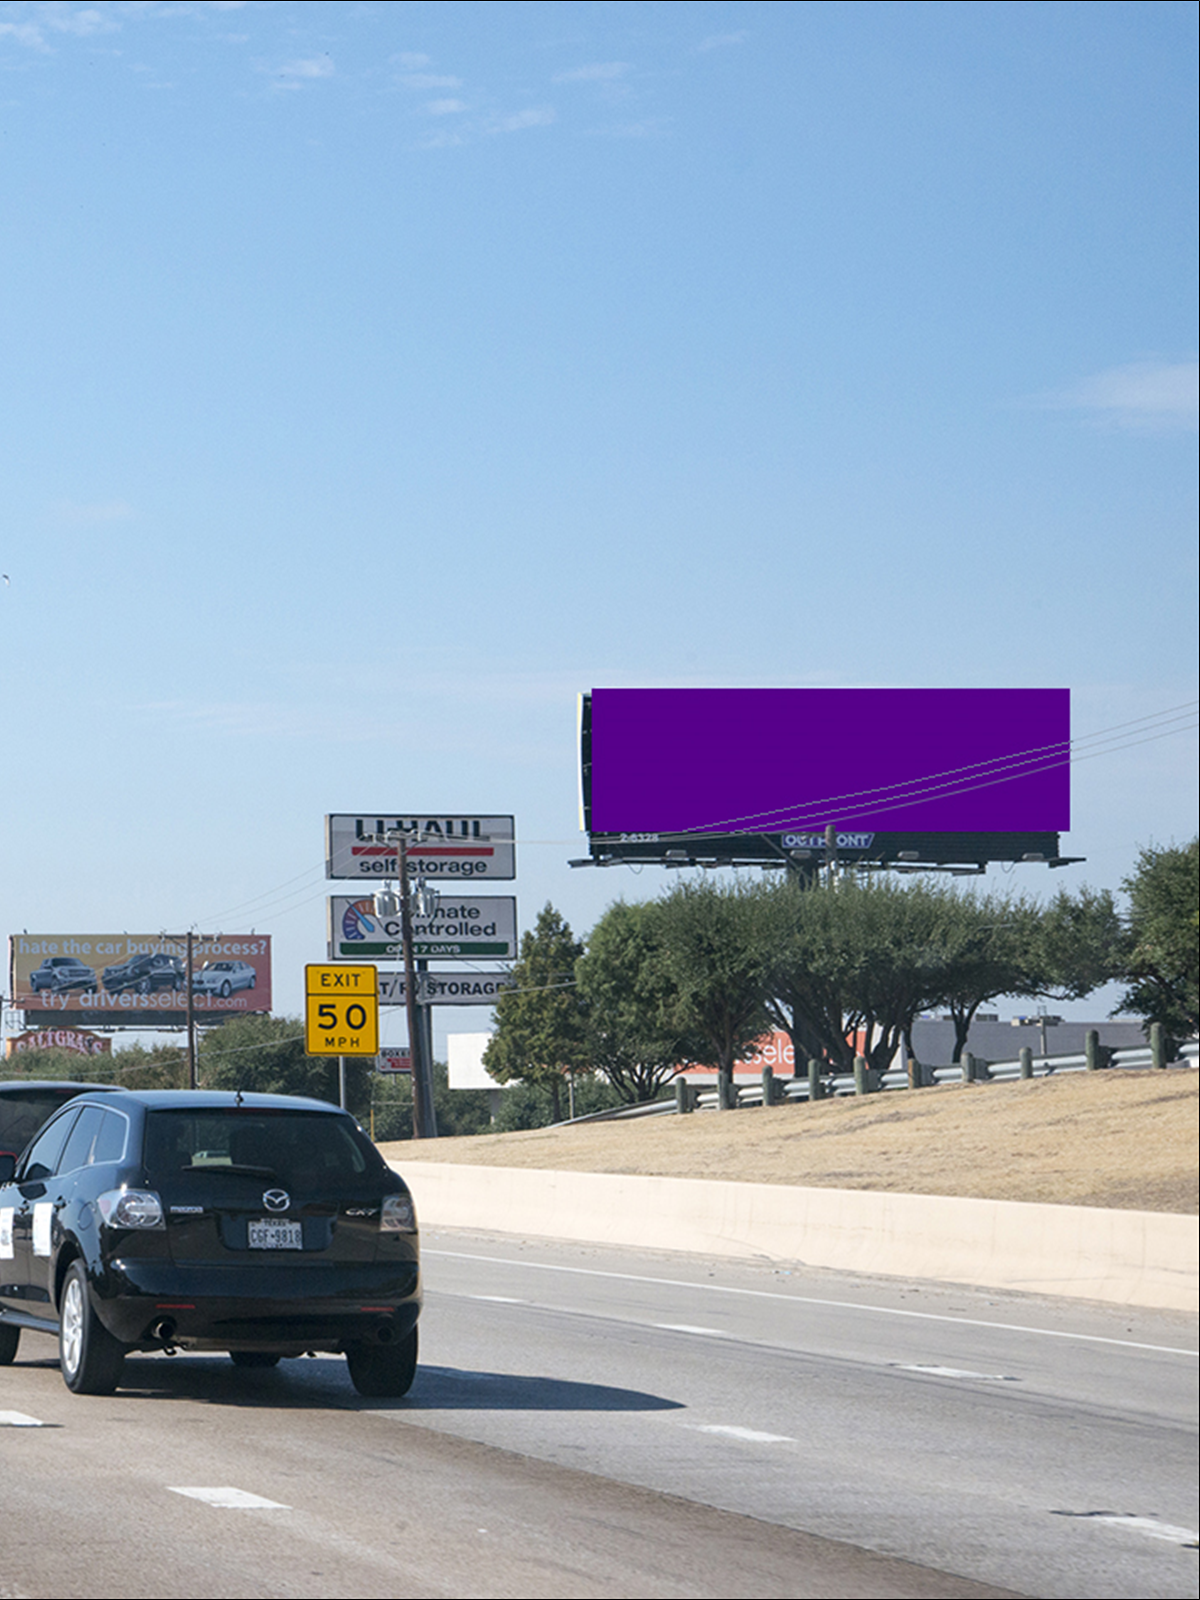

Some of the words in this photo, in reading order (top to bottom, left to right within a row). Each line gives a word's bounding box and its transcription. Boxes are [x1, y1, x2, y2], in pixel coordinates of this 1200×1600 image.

[785, 834, 869, 847] OUTFONT
[384, 921, 497, 937] Cntrolled
[19, 938, 58, 954] hate
[63, 938, 92, 954] the
[95, 942, 122, 954] car
[126, 939, 187, 959] buying
[193, 940, 267, 958] process?
[430, 945, 461, 954] DAYS
[321, 973, 361, 987] EXIT
[41, 991, 70, 1010] try
[318, 1004, 367, 1030] 50
[324, 1037, 360, 1047] MPH
[380, 1050, 411, 1058] BOXE
